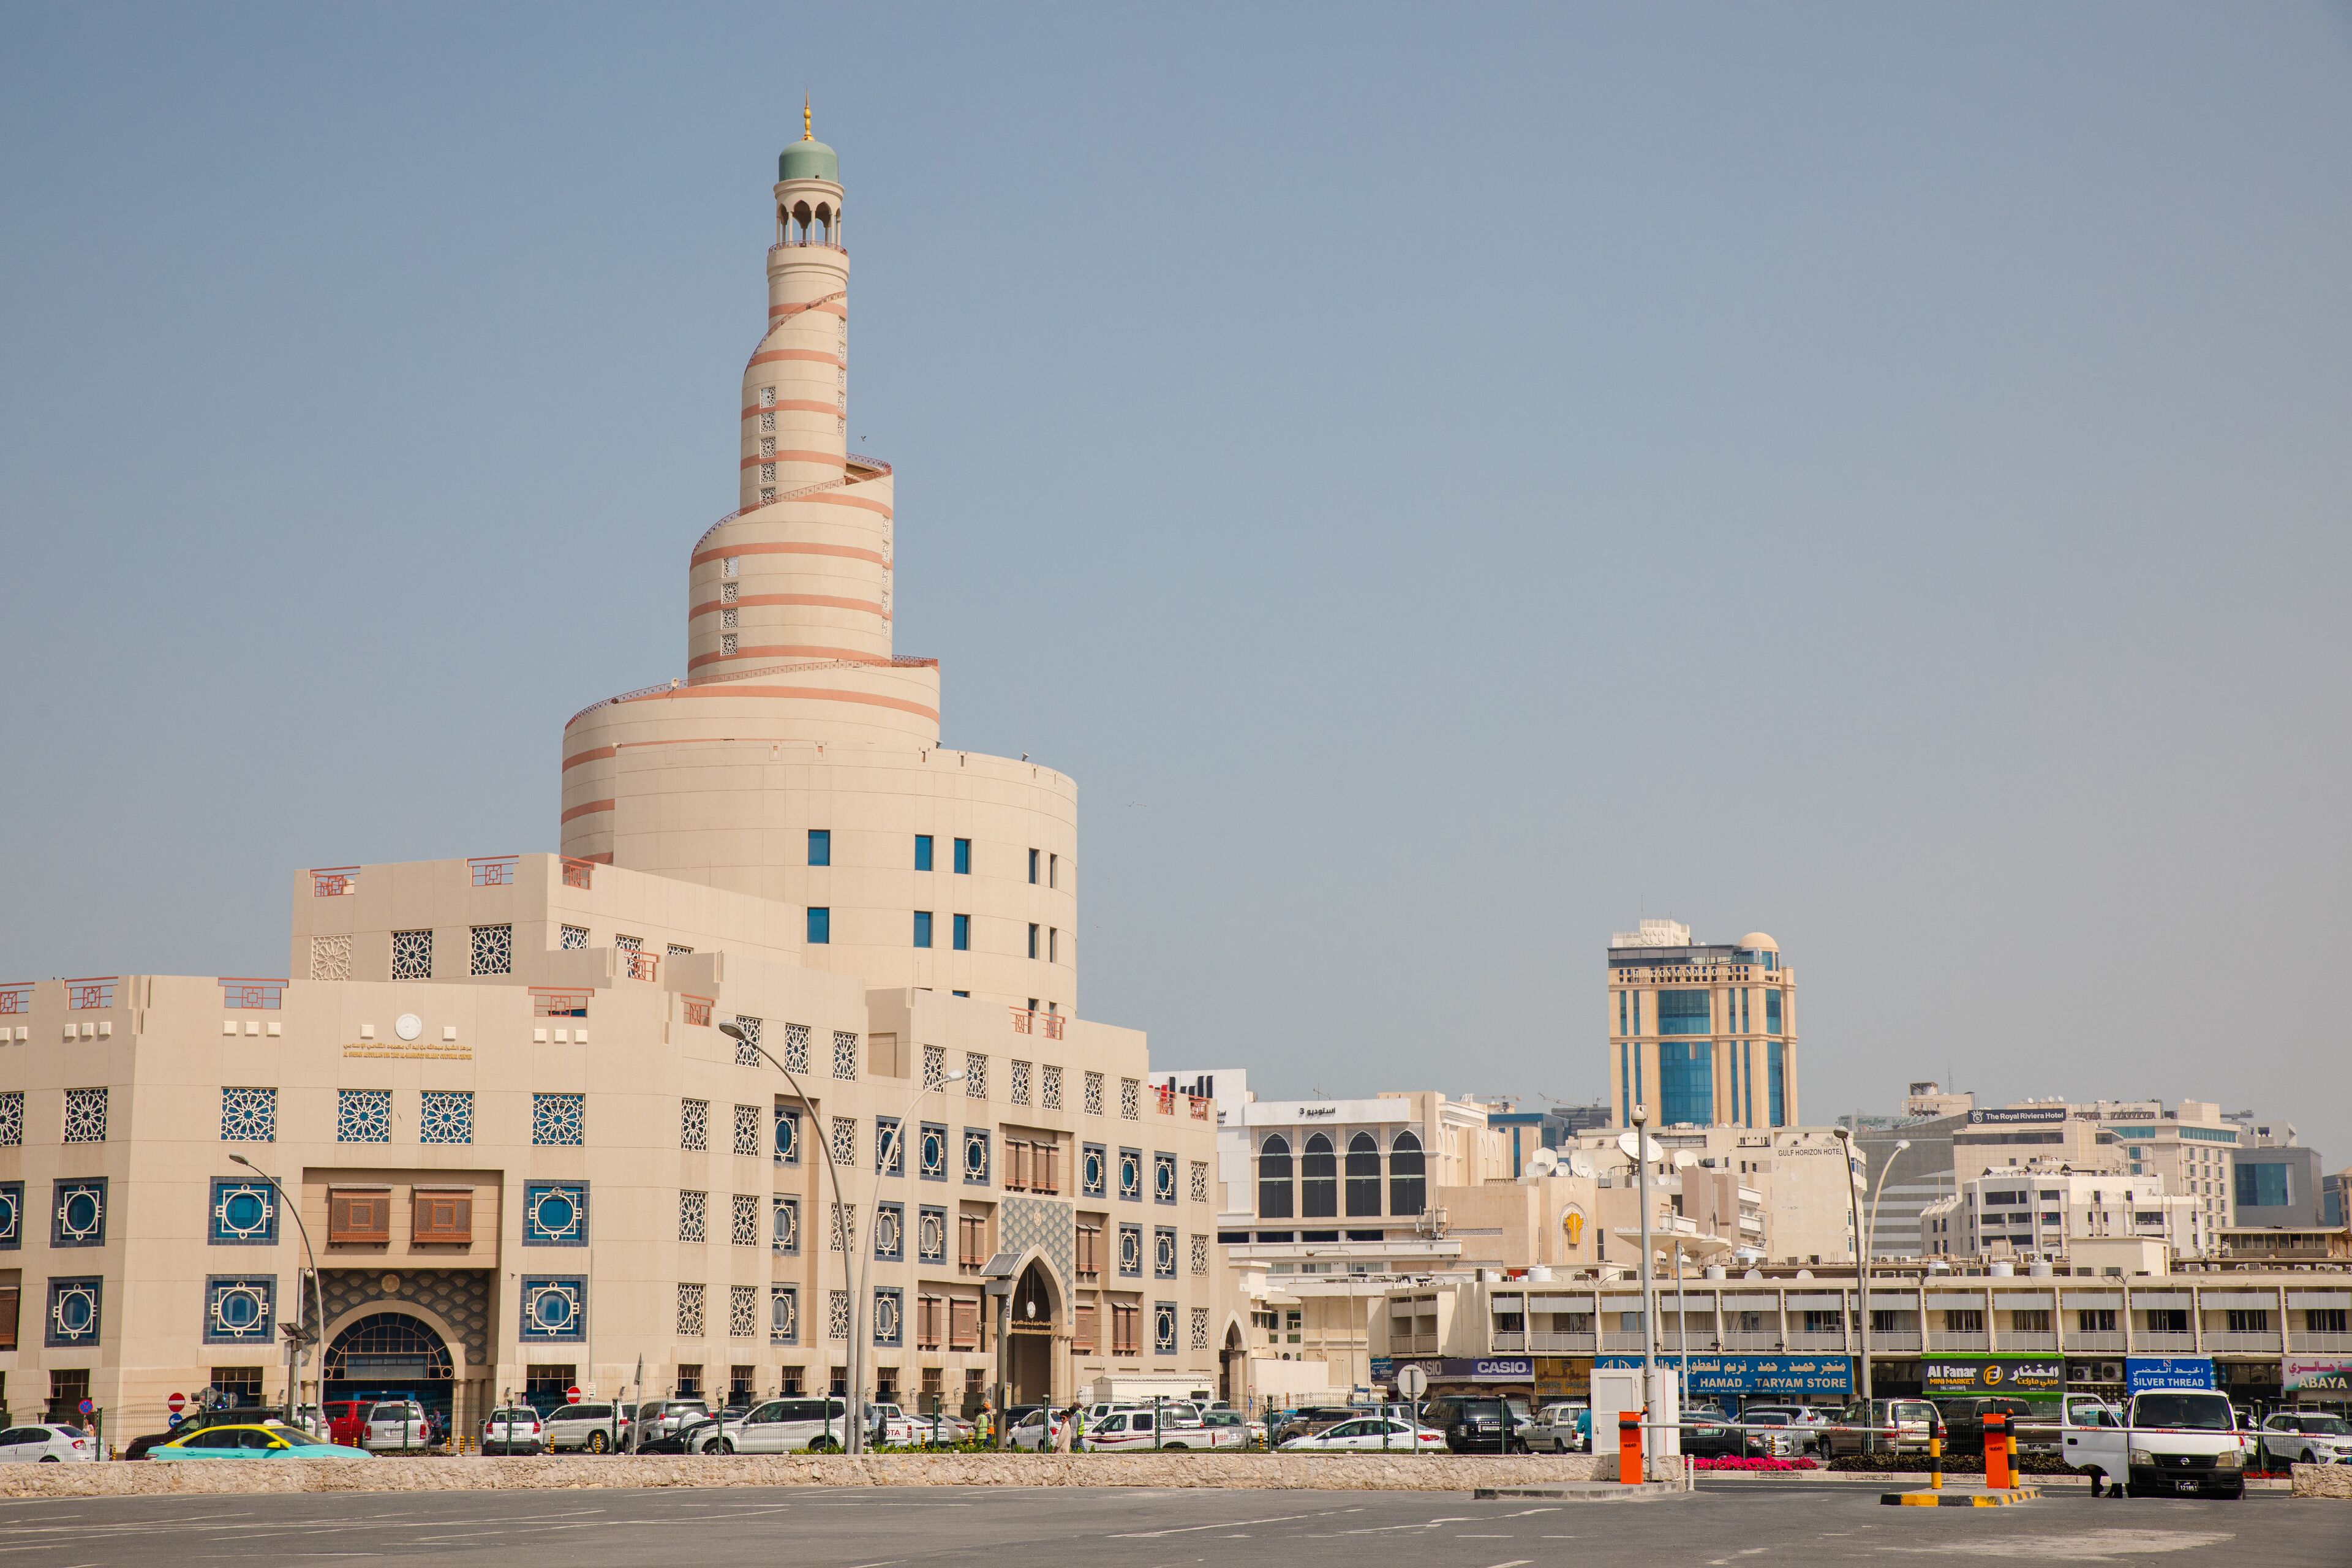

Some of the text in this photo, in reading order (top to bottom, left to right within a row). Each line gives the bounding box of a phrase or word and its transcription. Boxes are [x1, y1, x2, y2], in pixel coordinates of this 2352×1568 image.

[2000, 1112, 2019, 1121] Royal
[1415, 1360, 1442, 1376] ASIO
[1758, 1361, 1778, 1372] حمد
[1789, 1362, 1815, 1374] حميد
[1819, 1360, 1846, 1375] متجر
[1927, 1365, 1977, 1378] Al Fanar
[2008, 1363, 2059, 1381] الفنار
[2133, 1366, 2203, 1377] الخيط الفضي
[1700, 1378, 1847, 1388] HAMAD TARYAM STORE
[2016, 1377, 2059, 1387] ميني ماركت
[2133, 1378, 2204, 1387] SILVER THREAD
[2298, 1376, 2348, 1389] ABAYA
